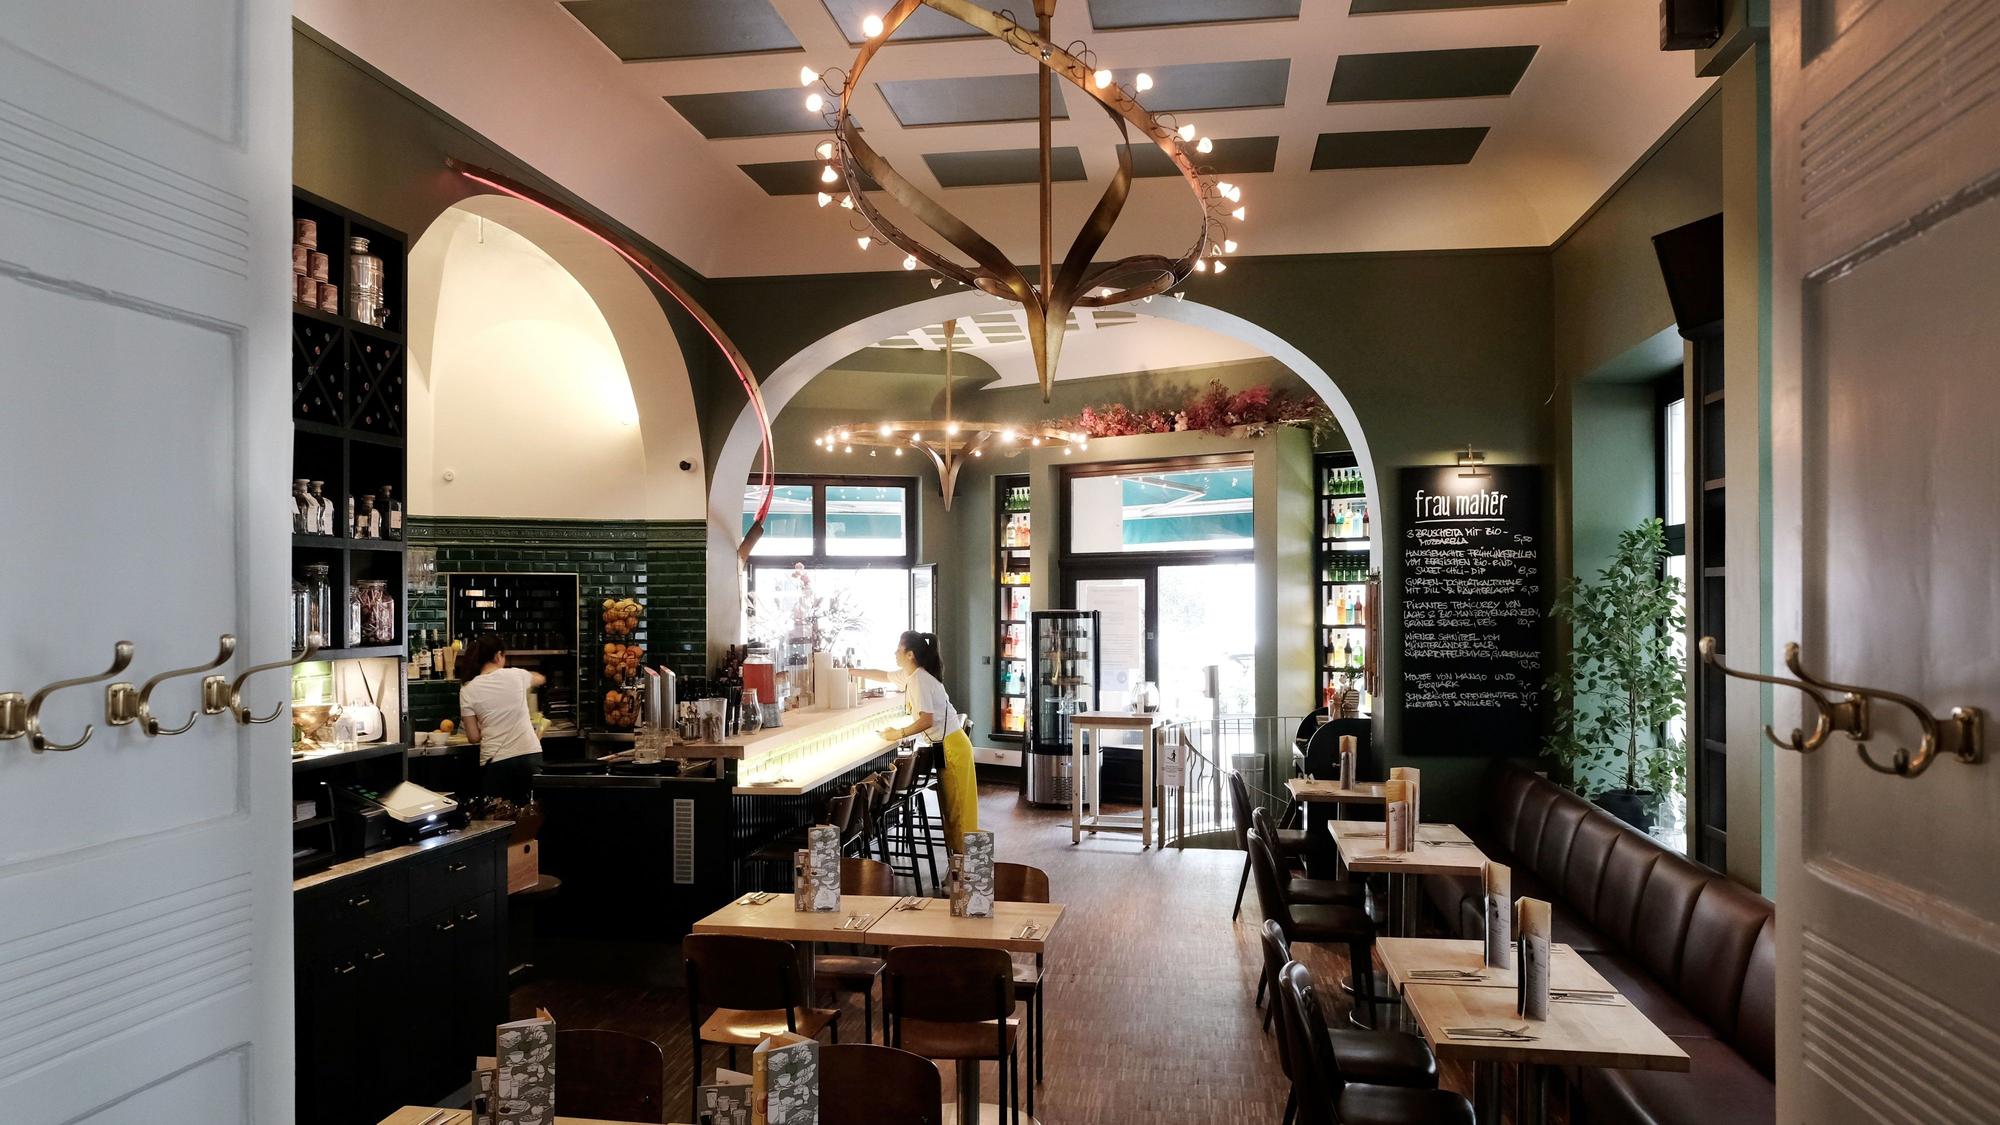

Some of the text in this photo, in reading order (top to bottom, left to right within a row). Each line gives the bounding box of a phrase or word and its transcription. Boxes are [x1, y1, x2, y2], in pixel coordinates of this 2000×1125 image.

[1415, 490, 1450, 517] frau
[1514, 534, 1532, 545] 5,50
[1406, 549, 1465, 558] HAUSGEMACHTE
